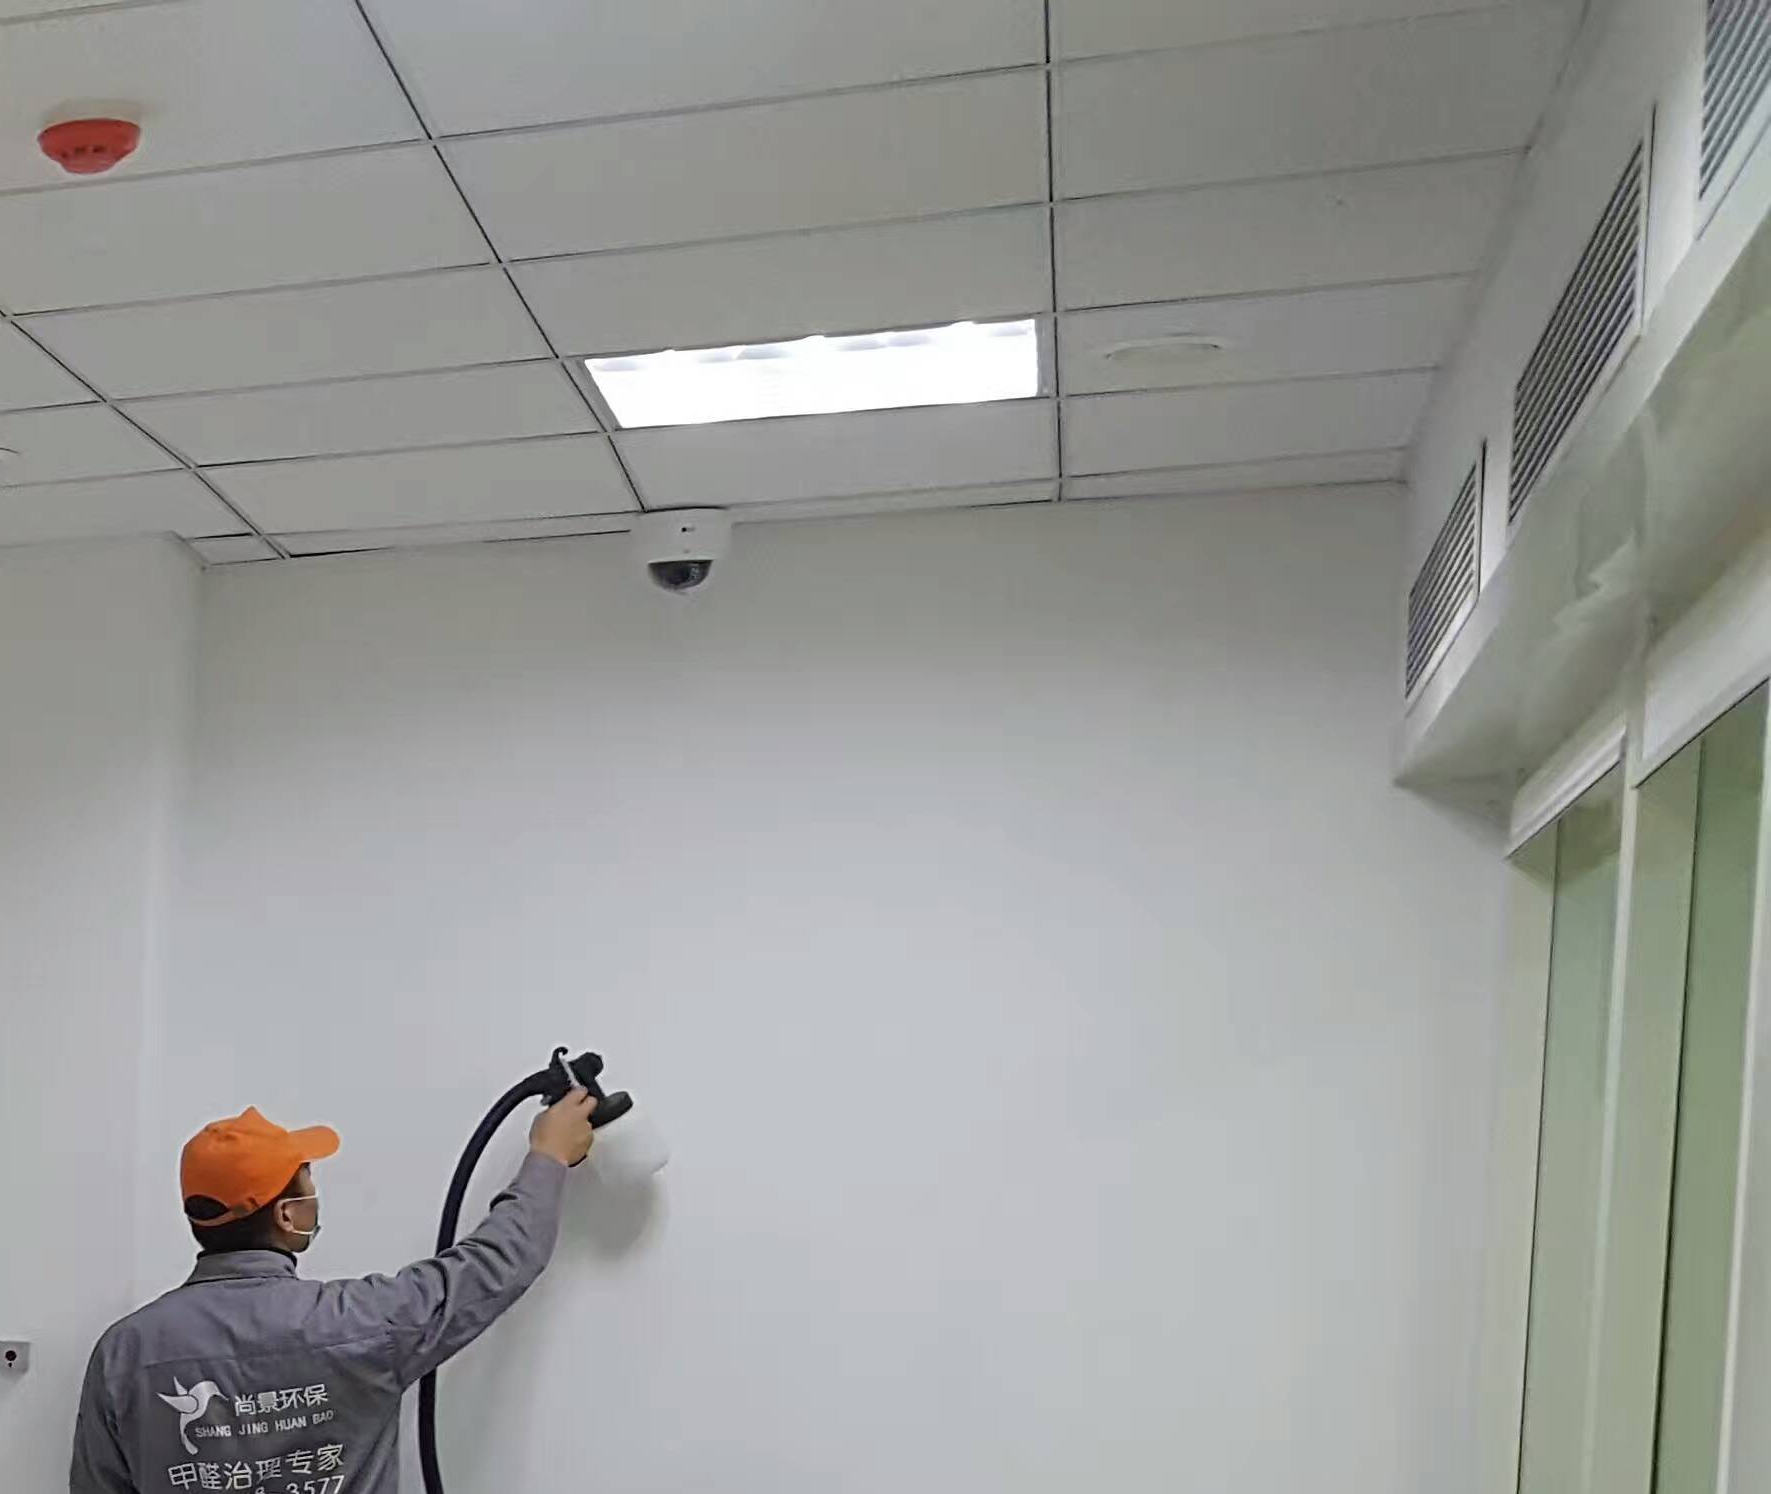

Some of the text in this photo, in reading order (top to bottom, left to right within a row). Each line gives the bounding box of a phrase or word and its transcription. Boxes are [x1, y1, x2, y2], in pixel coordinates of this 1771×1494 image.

[234, 1384, 329, 1417] 尚景环保
[195, 1409, 334, 1438] SHANG JING HUAN BAO
[167, 1444, 345, 1491] 甲醛治理专家
